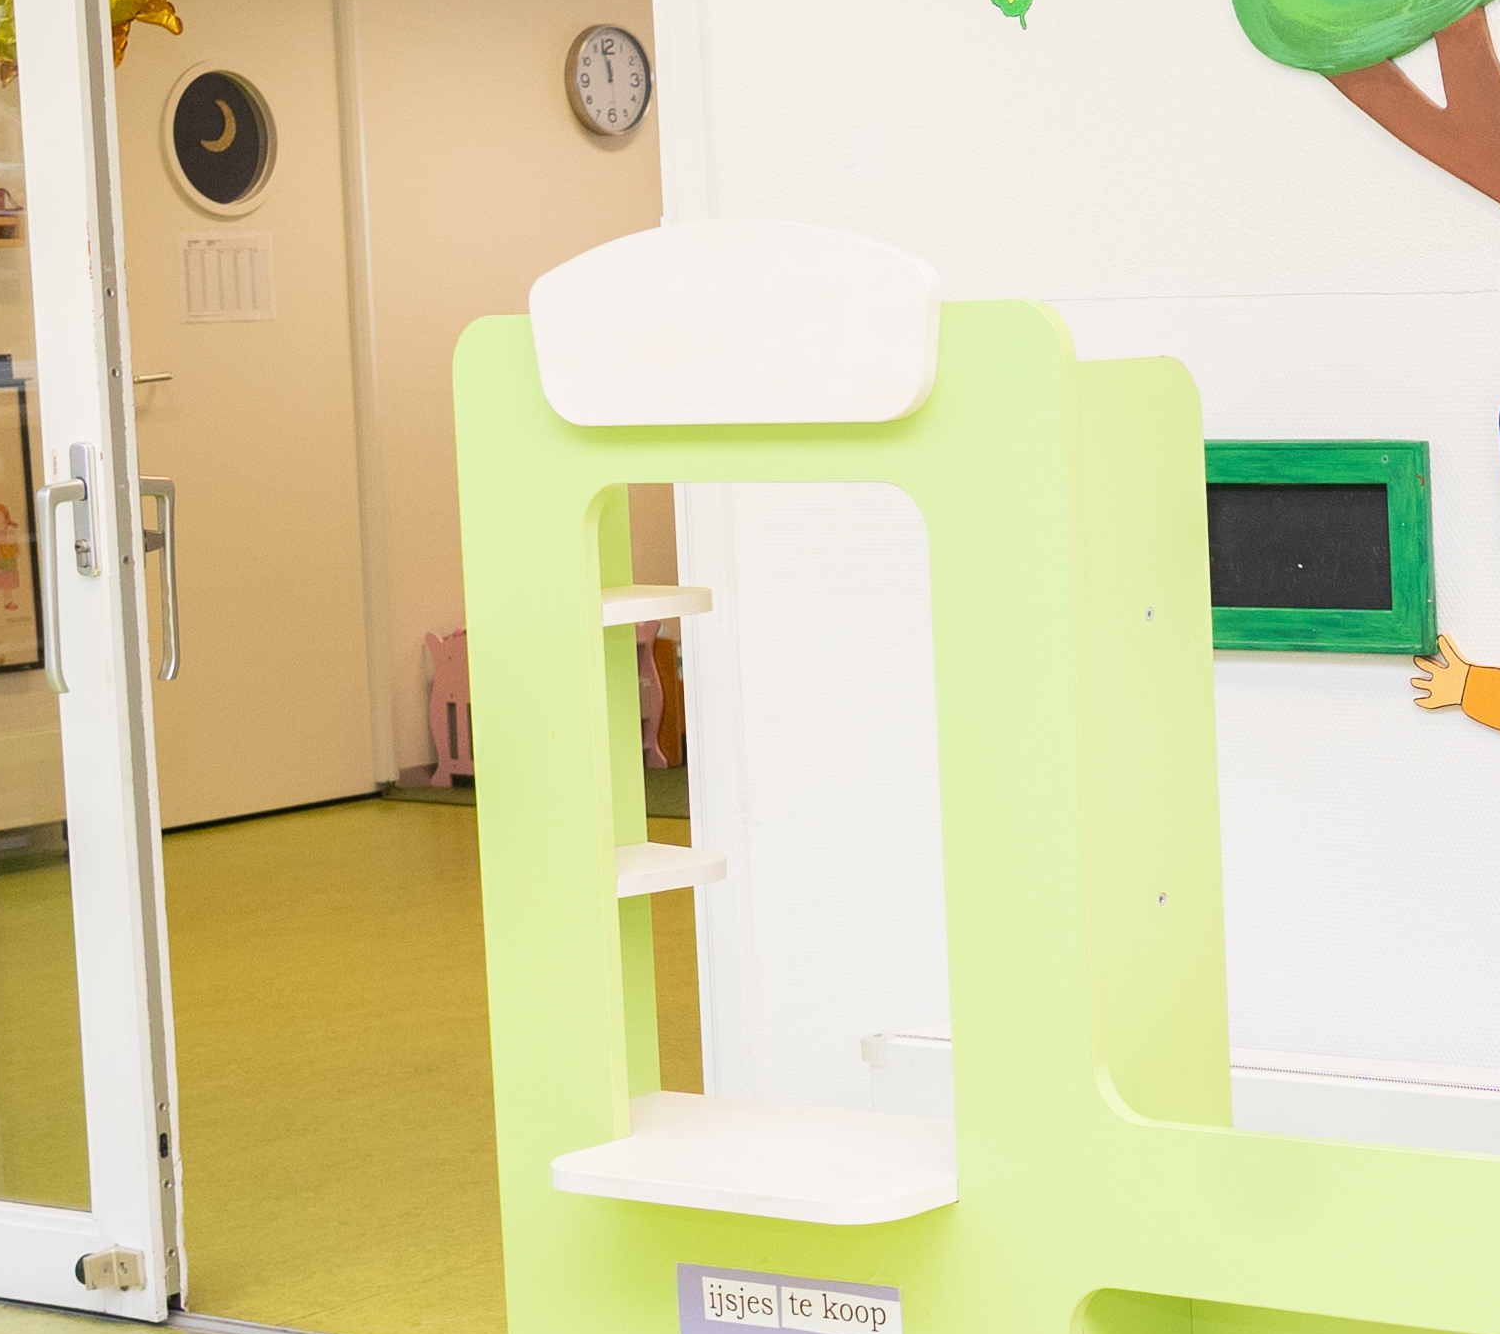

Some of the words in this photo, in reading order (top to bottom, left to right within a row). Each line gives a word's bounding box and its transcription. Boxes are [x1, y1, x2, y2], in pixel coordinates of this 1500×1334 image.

[601, 38, 616, 56] 12
[580, 72, 591, 89] 9
[630, 72, 641, 88] 3
[607, 107, 618, 124] 6
[709, 1283, 774, 1320] ijsjes
[788, 1292, 813, 1318] te
[821, 1293, 887, 1333] koop
